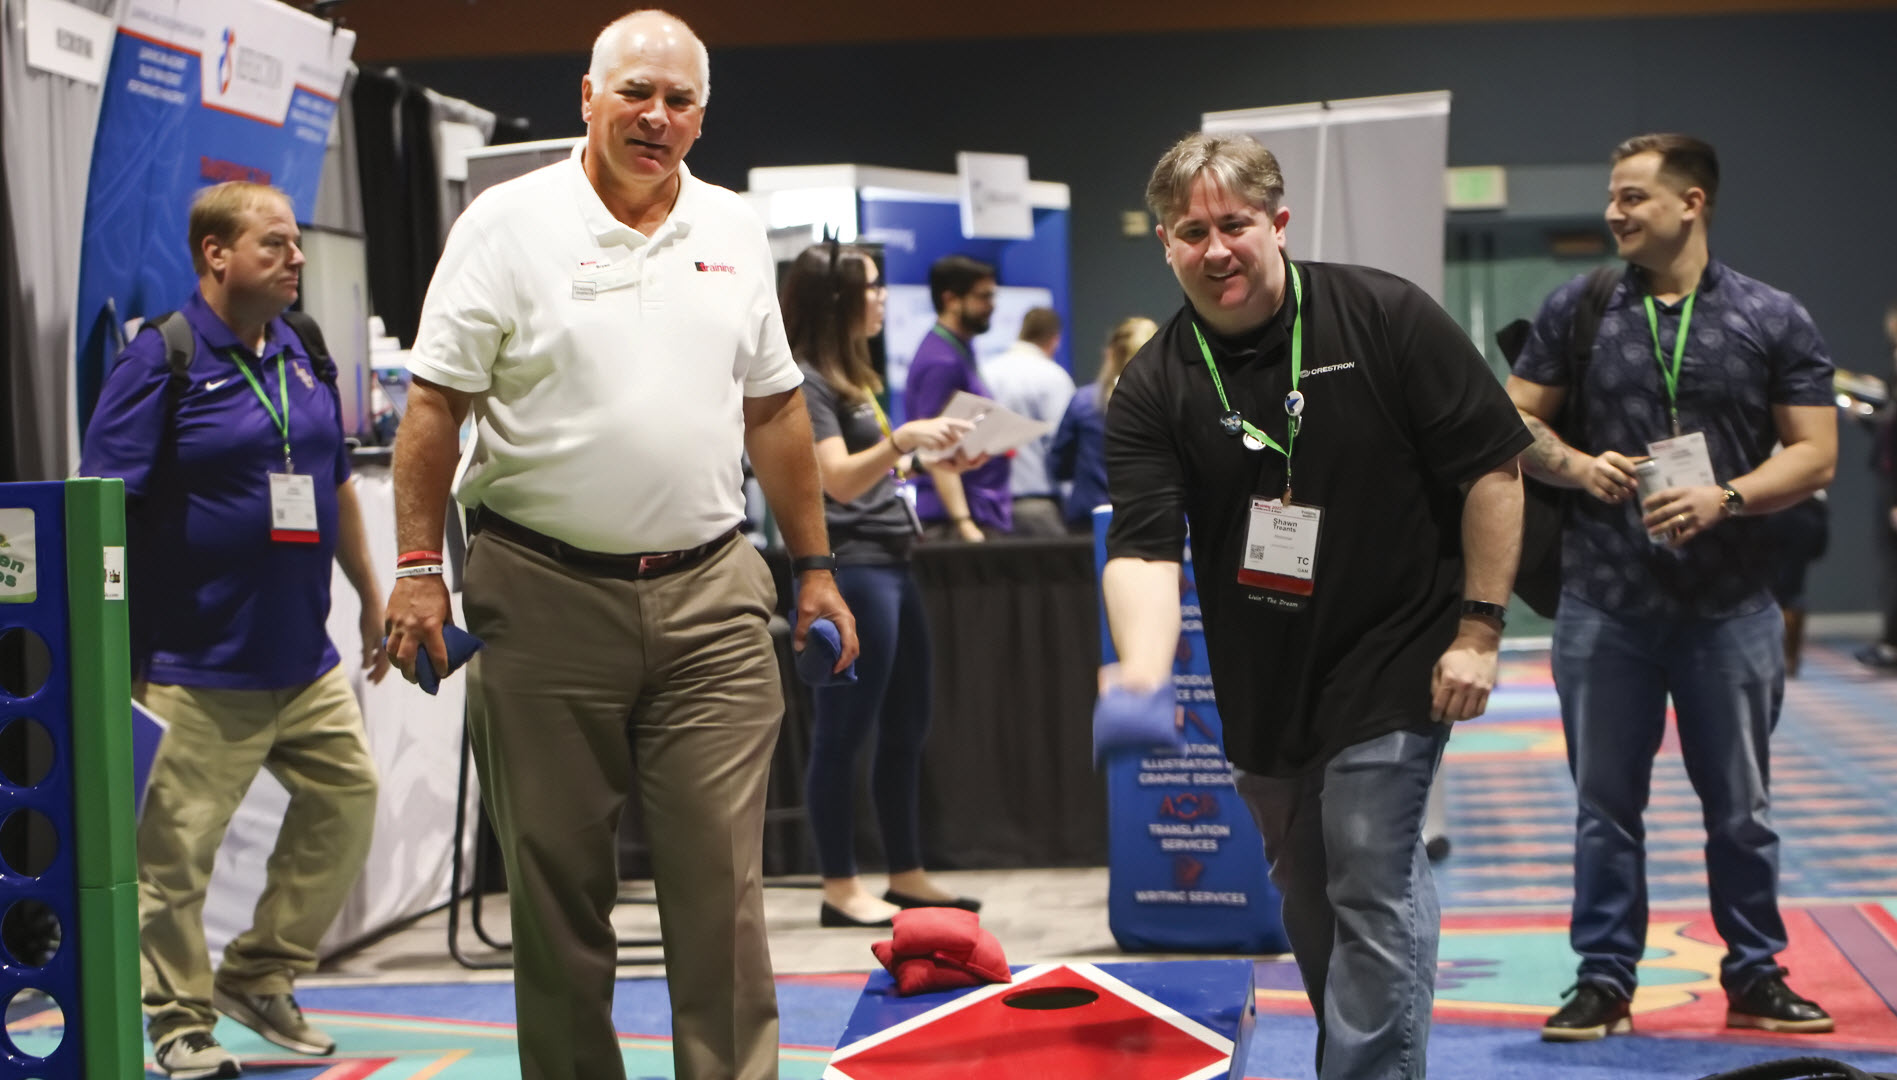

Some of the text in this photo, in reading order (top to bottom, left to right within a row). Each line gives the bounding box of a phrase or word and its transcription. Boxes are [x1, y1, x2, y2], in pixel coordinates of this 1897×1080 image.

[1311, 361, 1355, 375] CRESTRON
[1273, 517, 1298, 528] Shawn
[1297, 556, 1310, 566] TC
[1279, 599, 1298, 607] Dream
[1149, 824, 1231, 838] TRANSLATION
[1161, 838, 1219, 852] SERVICES
[1135, 890, 1248, 906] WRITING SERVICES
